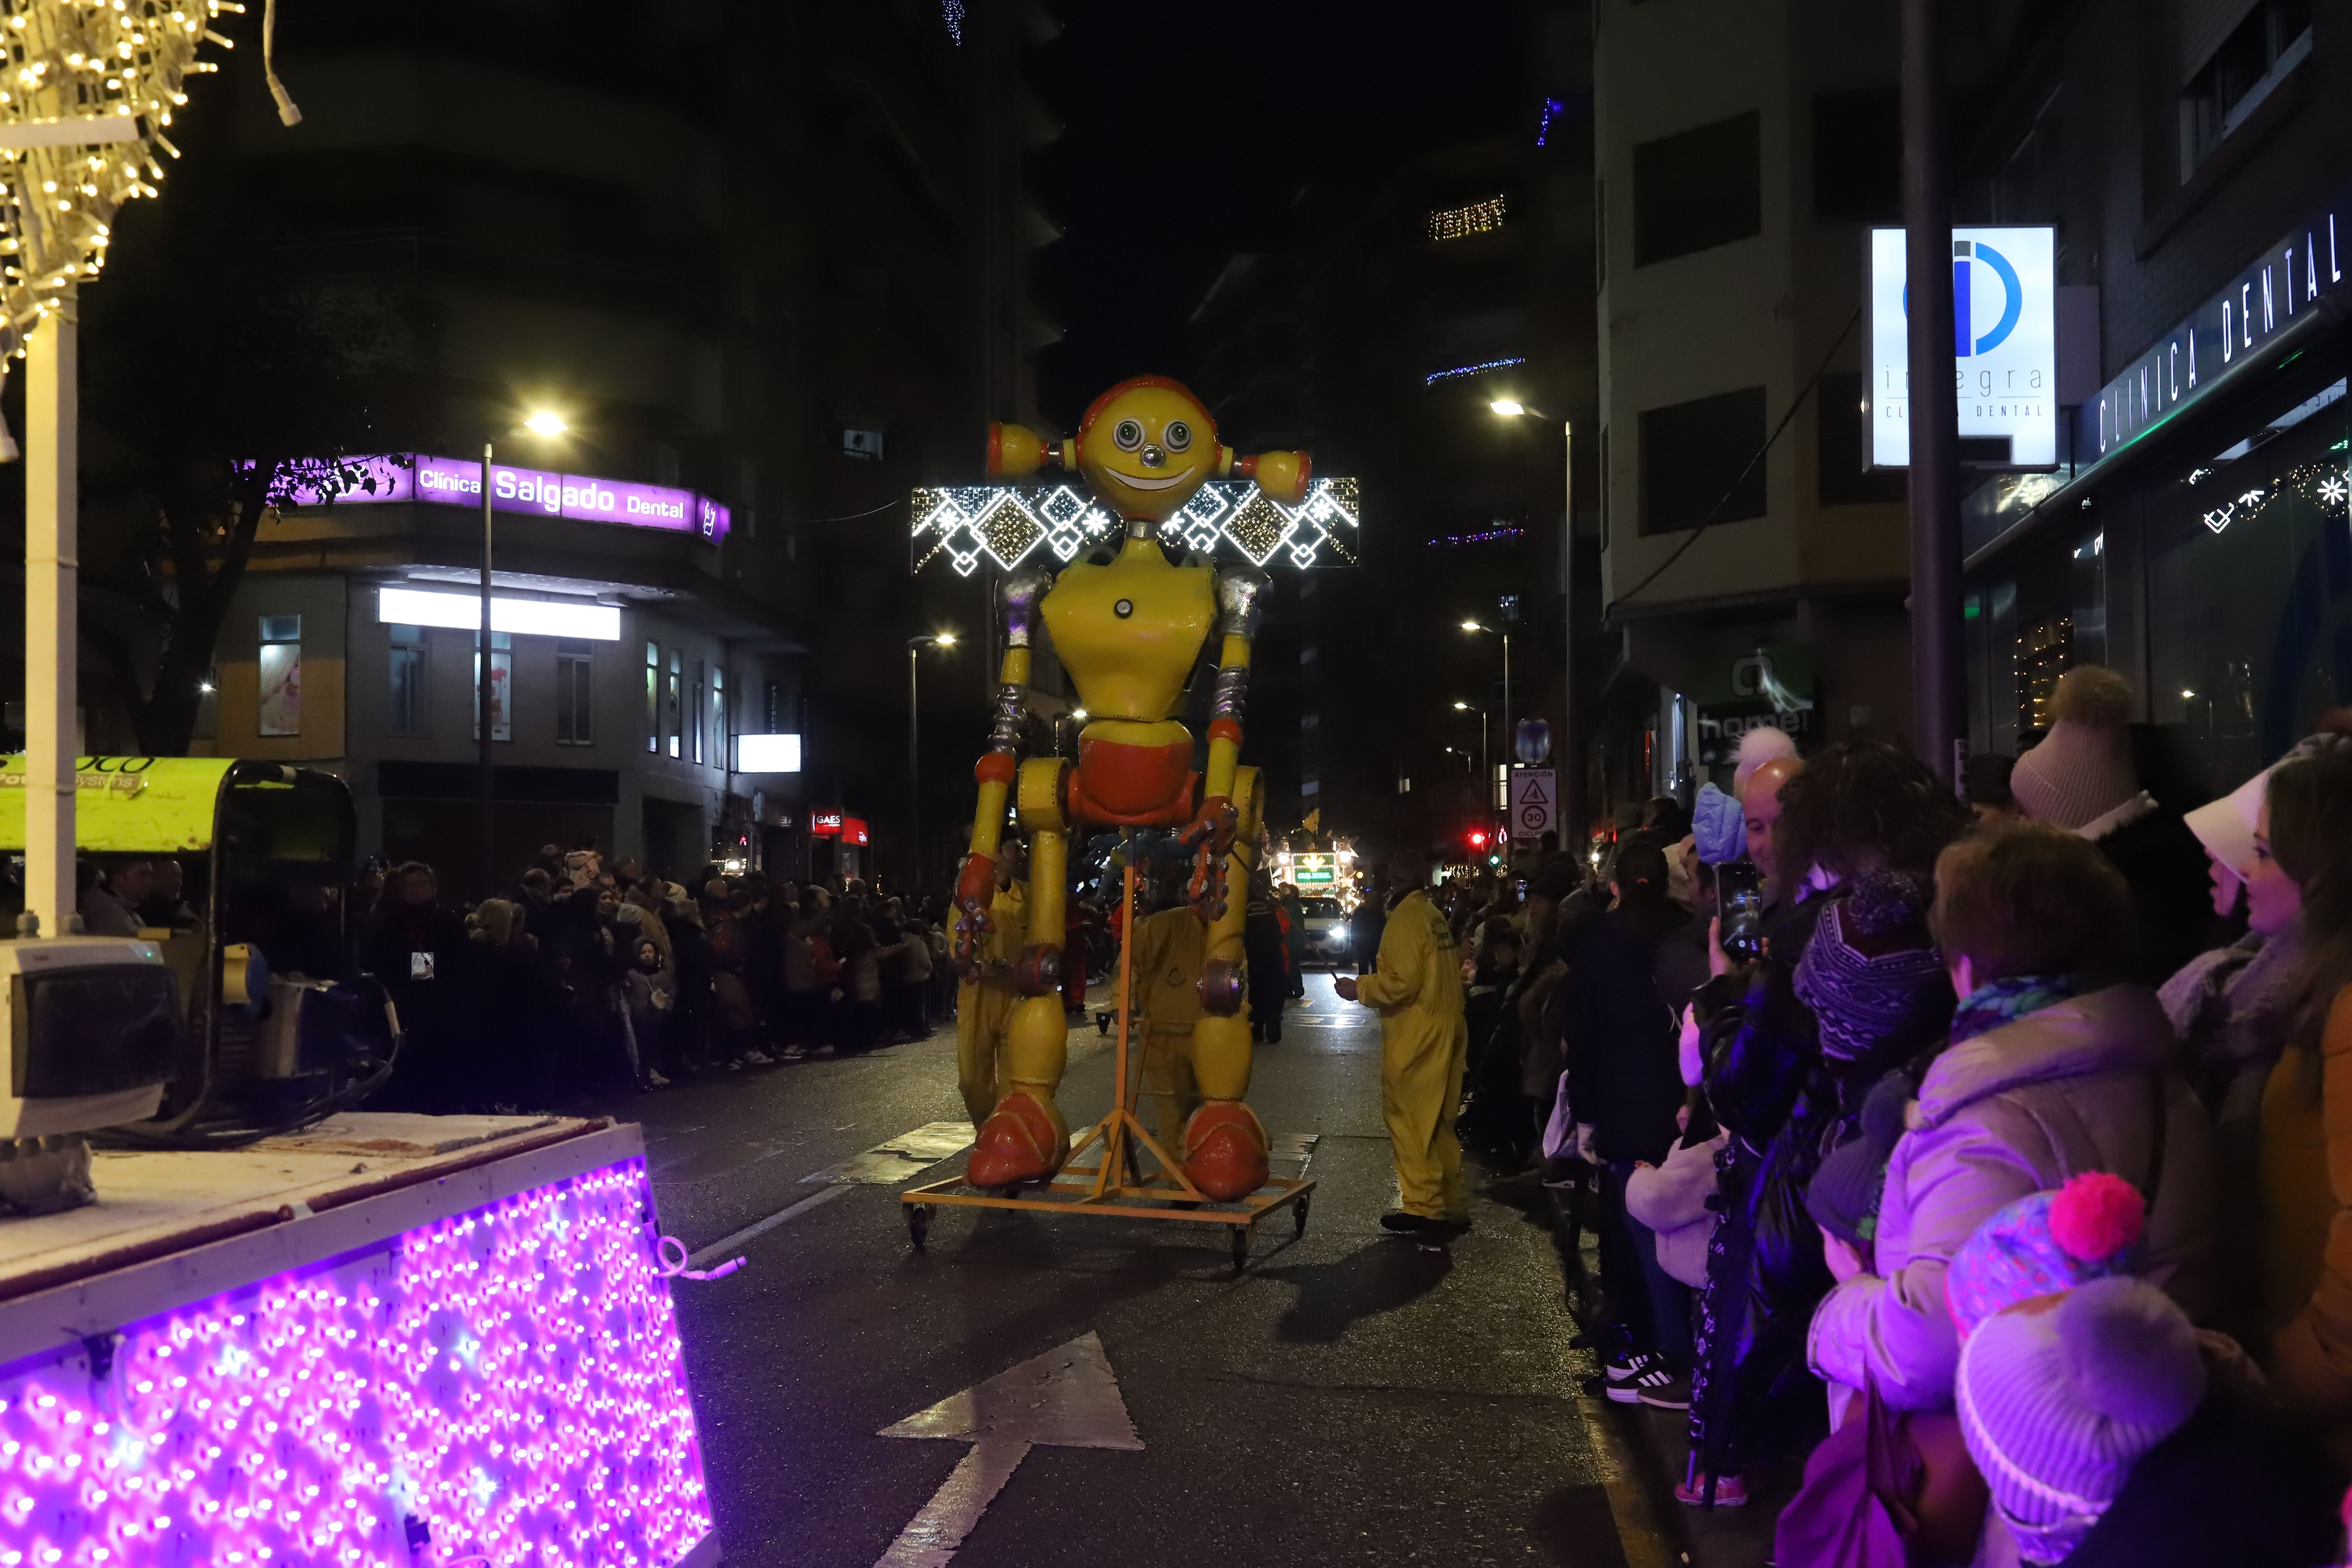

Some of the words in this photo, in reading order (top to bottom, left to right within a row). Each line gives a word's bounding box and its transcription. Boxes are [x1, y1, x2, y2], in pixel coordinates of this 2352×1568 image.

[2099, 328, 2196, 453] CLINICA
[2223, 213, 2341, 363] DENTAL
[1886, 365, 2041, 397] iegra
[1977, 406, 2041, 417] DENTAL
[419, 469, 481, 494] Clínica
[495, 470, 614, 513] Salgado
[627, 496, 684, 519] Dental
[817, 815, 841, 824] GAES
